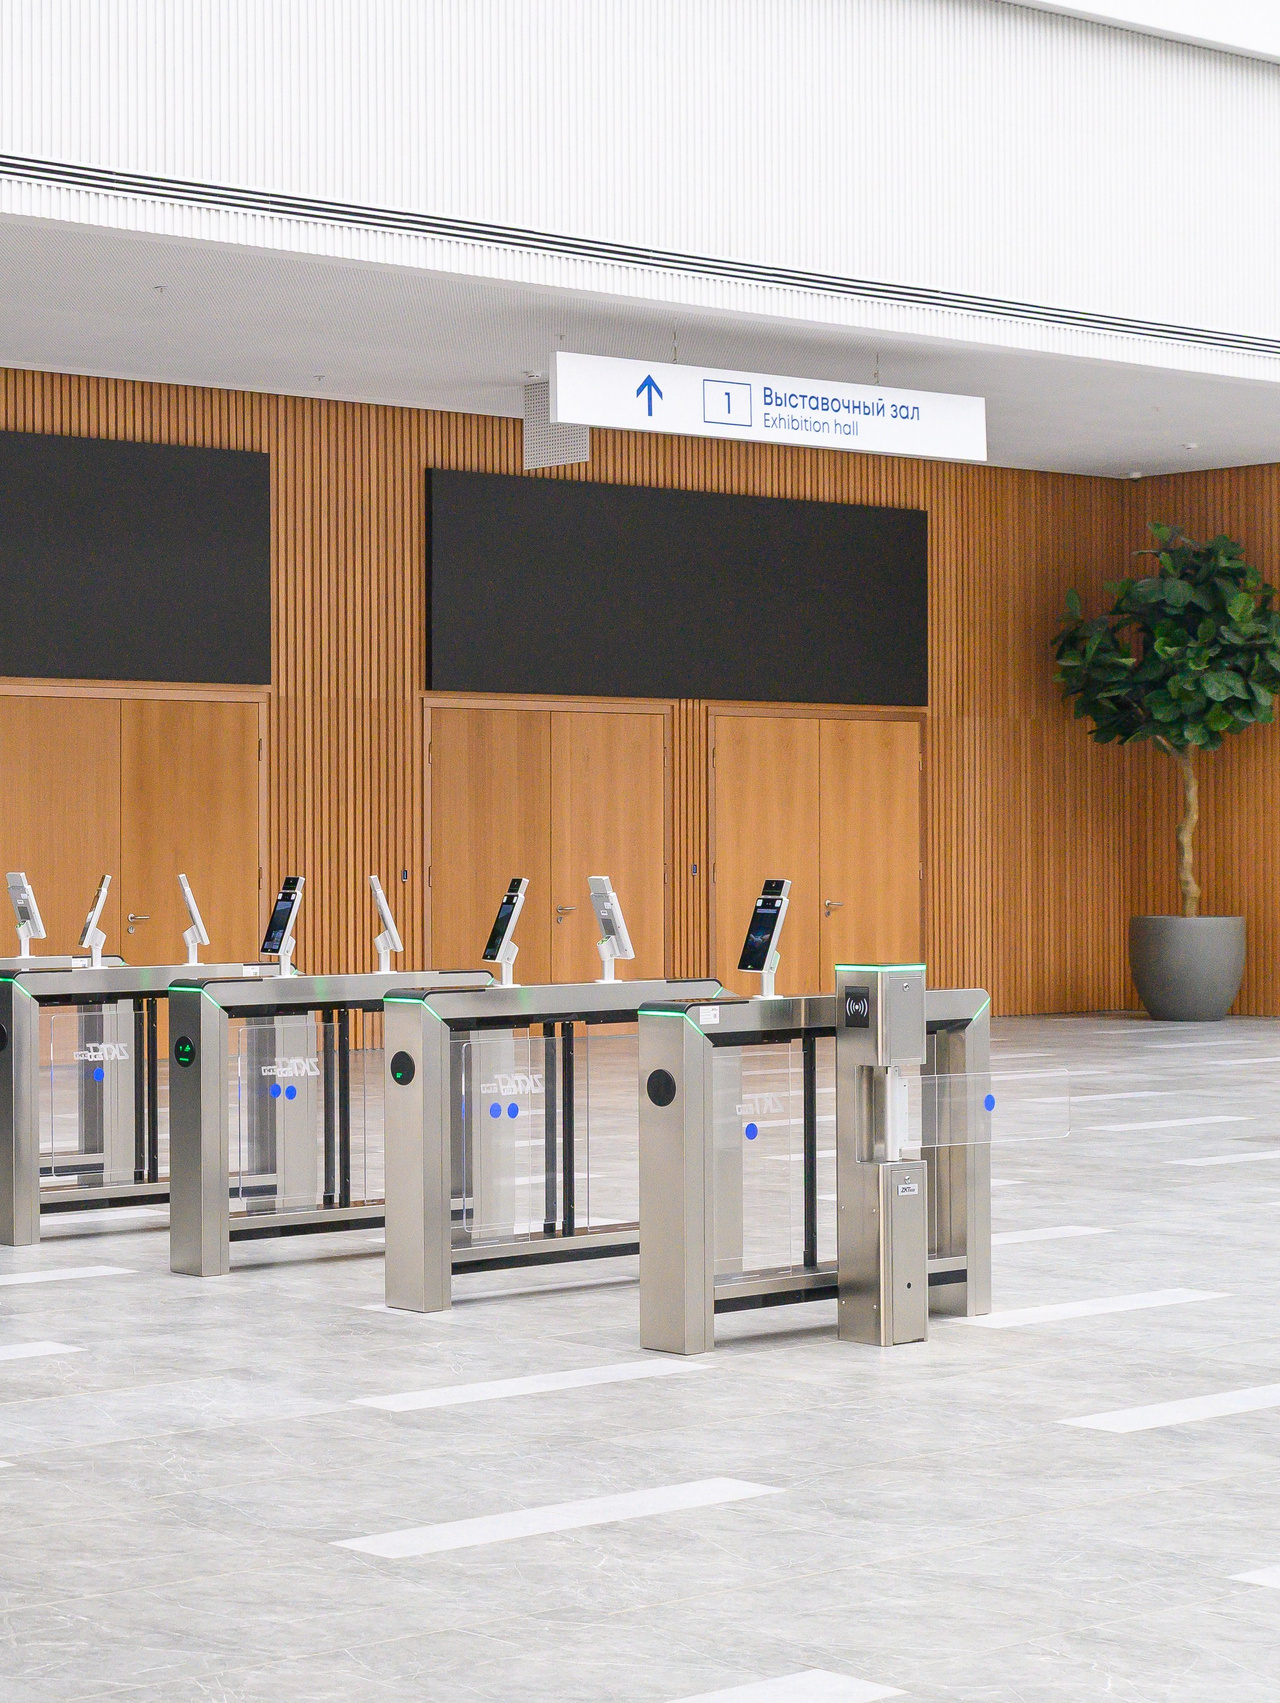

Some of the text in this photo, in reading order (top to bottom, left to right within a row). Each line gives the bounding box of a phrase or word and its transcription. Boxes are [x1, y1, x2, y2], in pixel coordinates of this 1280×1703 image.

[724, 391, 731, 415] 1
[762, 386, 920, 421] Выставочный зал
[763, 412, 859, 436] Exhibition hall
